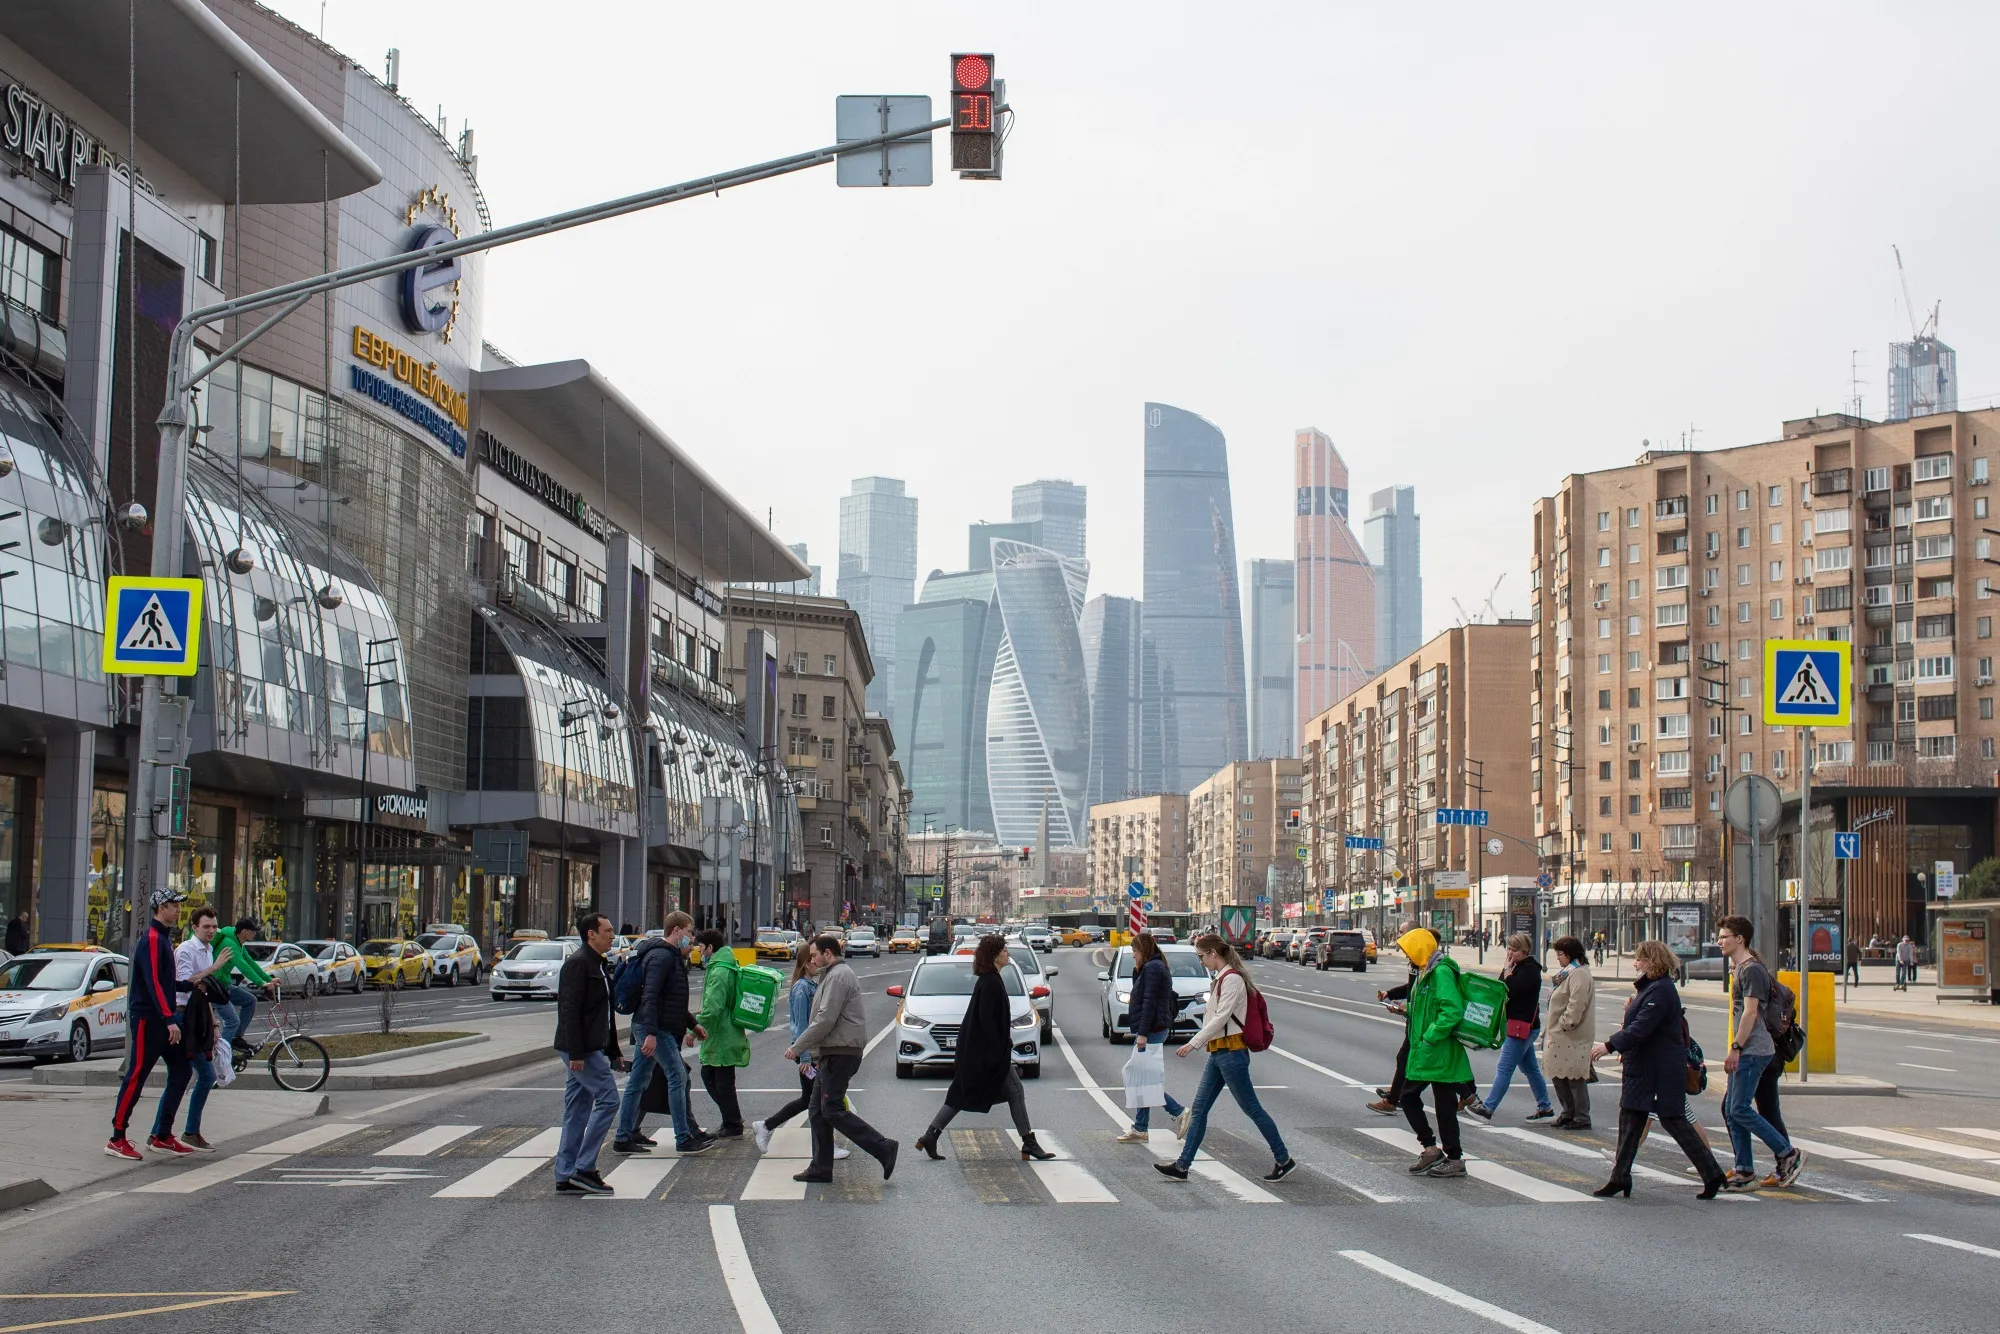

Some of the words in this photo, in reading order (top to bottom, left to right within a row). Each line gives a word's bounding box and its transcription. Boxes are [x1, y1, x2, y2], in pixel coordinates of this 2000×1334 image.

[4, 83, 66, 180] STAR
[960, 94, 989, 128] 30
[353, 325, 469, 431] ЕВРОПЕЙСКИЙ
[487, 431, 542, 493] VICTORIA'S
[544, 473, 577, 517] SECRET
[378, 794, 428, 819] СТОКМАНН
[98, 1008, 126, 1026] Ситим
